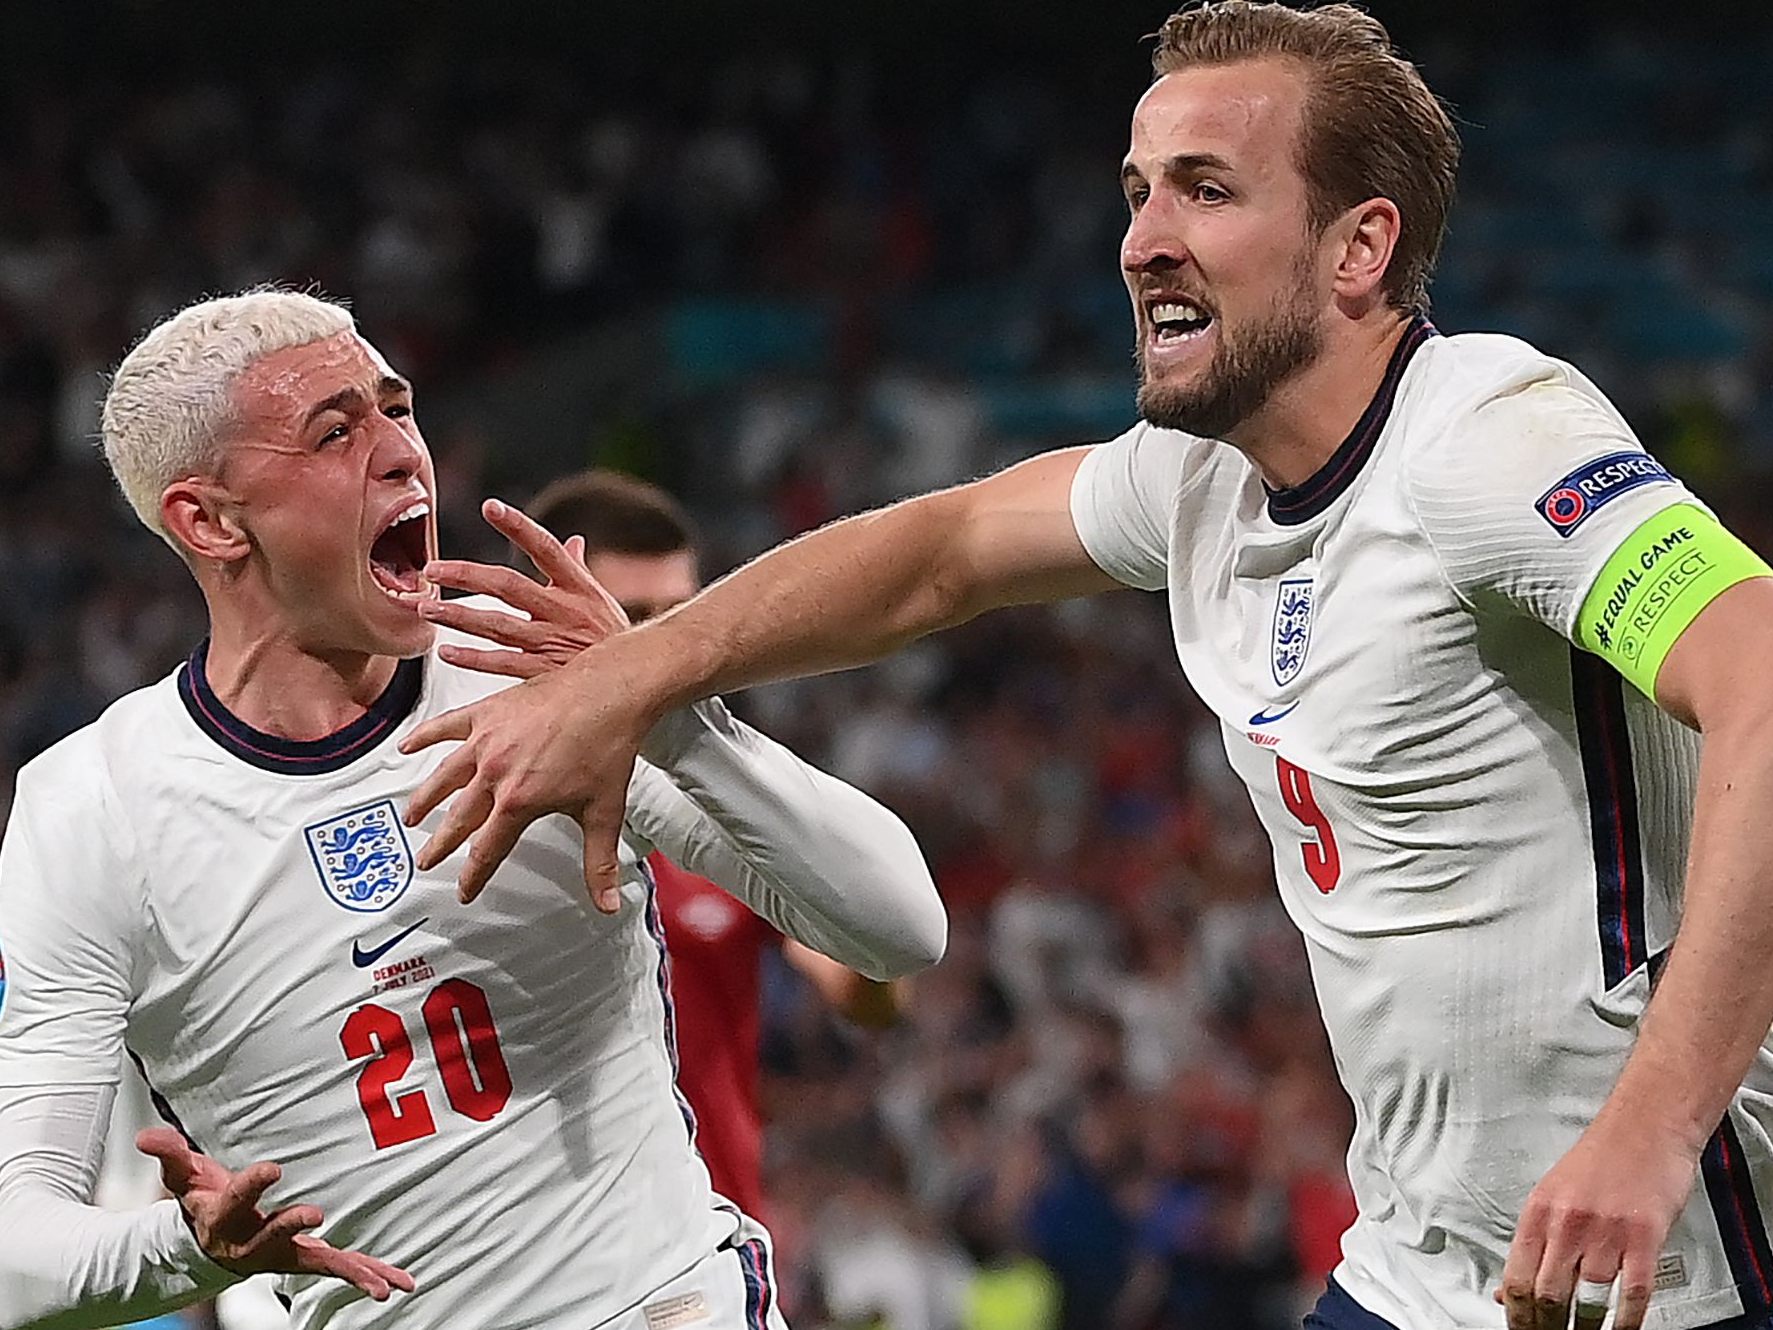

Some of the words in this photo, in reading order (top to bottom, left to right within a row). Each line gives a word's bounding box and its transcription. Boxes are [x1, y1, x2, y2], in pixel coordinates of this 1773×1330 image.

[1594, 568, 1644, 651] #EQUAL
[1640, 527, 1695, 570] GAME
[1633, 551, 1707, 633] RESPECT
[1276, 754, 1341, 894] 9
[373, 955, 427, 981] DENMARK
[339, 977, 514, 1150] 20
